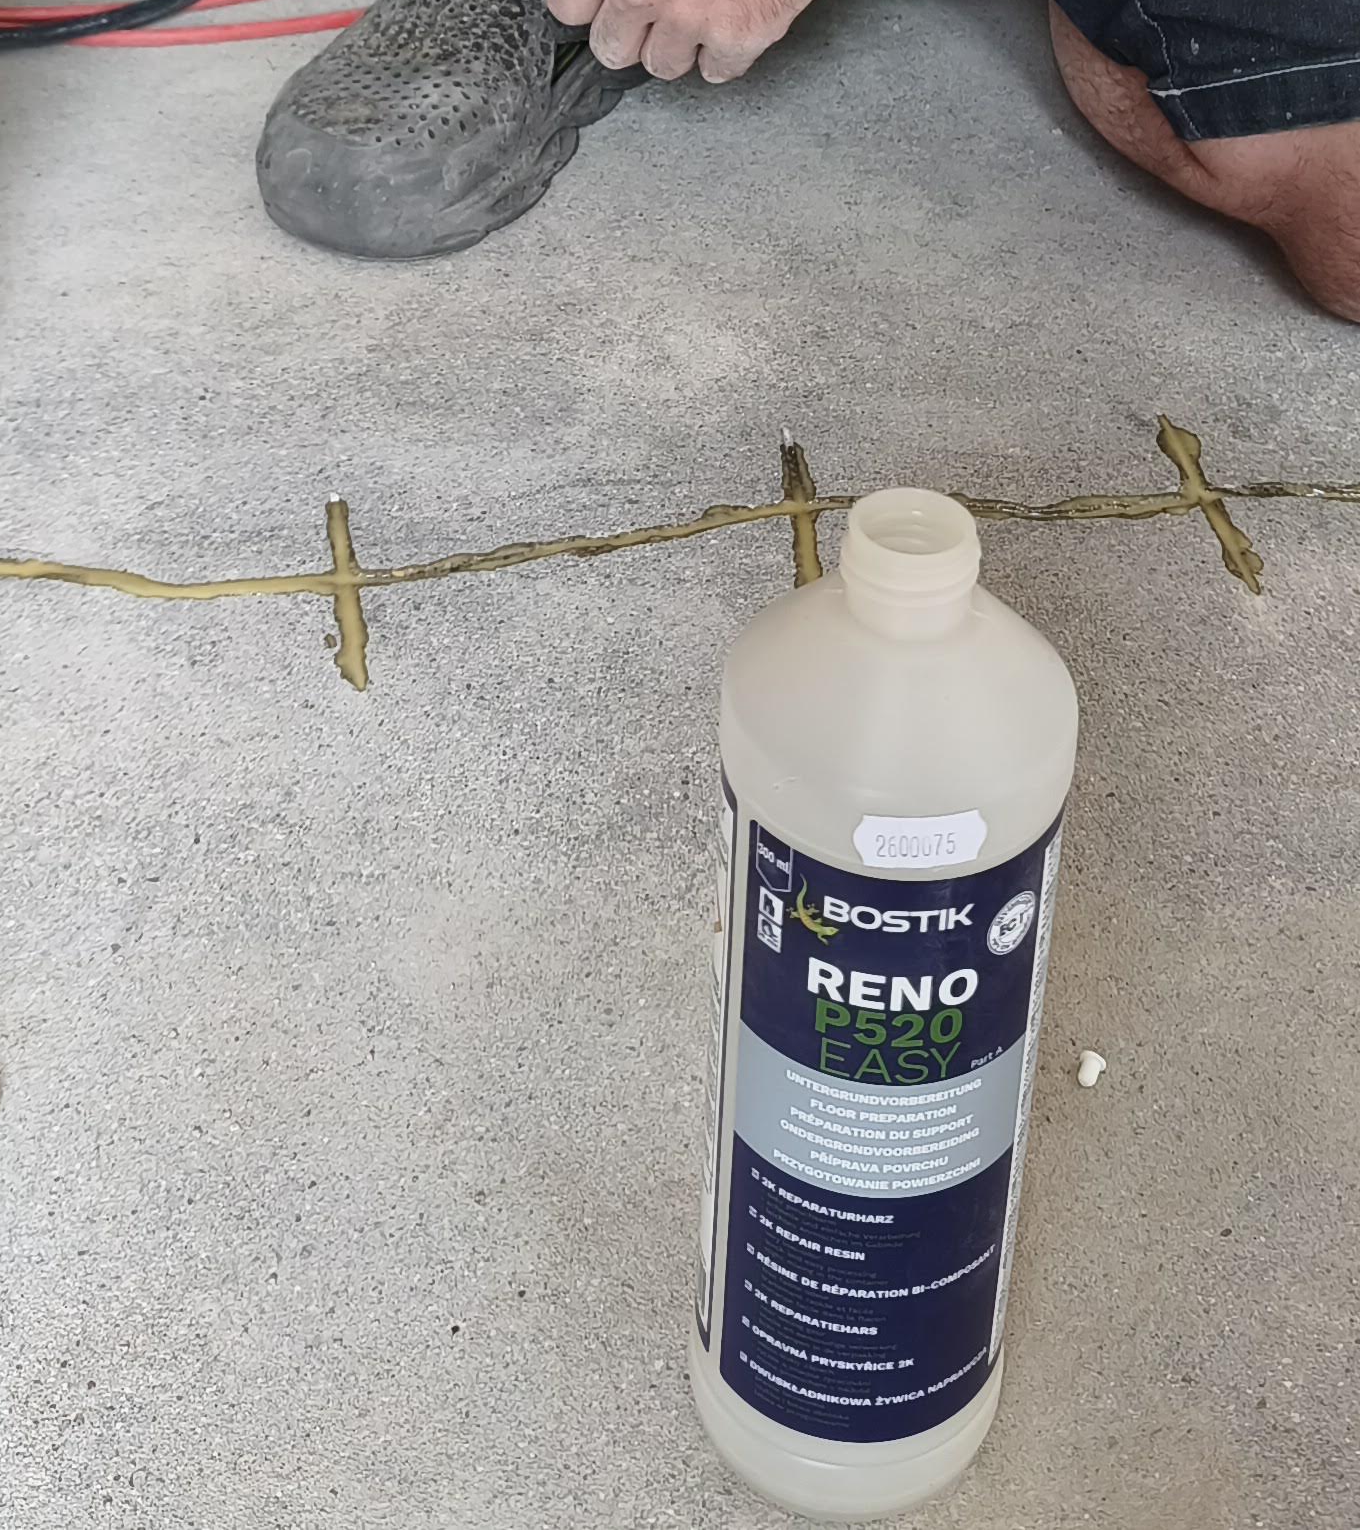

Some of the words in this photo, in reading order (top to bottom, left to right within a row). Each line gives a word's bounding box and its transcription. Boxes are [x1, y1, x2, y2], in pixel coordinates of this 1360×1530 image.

[875, 832, 957, 858] 2600075
[823, 895, 976, 933] BOSTIK
[807, 957, 979, 1012] RENO
[815, 998, 963, 1047] P520
[820, 1037, 962, 1084] EASY
[970, 1052, 994, 1069] Part
[786, 1069, 982, 1106] UNTERGRUNDVORBEREITUNG
[790, 1106, 886, 1140] PRÉPARATION
[889, 1129, 910, 1140] DU
[912, 1114, 975, 1139] SUPPORT
[810, 1098, 857, 1120] FLOOR
[859, 1105, 957, 1124] PREPARATION
[780, 1119, 980, 1157] ONDERGRONDVOORBEREIDING
[773, 1149, 889, 1190] PRZYGOTOWANIE
[892, 1157, 981, 1190] POWIERZCHNI
[810, 1150, 880, 1174] PŘÍPRAVA
[882, 1156, 949, 1174] POVRCHU
[761, 1176, 776, 1192] 2K
[778, 1188, 895, 1224] REPARATURHARZ
[759, 1215, 774, 1230] 2K
[776, 1225, 821, 1252] REPAIR
[824, 1246, 866, 1261] RESIN
[757, 1250, 798, 1281] RÉSINE
[801, 1276, 819, 1290] DE
[821, 1283, 908, 1299] RÉPARATION
[754, 1288, 769, 1304] 2K
[771, 1299, 879, 1336] REPARATIEHARS
[752, 1325, 809, 1361] OPRAVNÁ
[811, 1354, 895, 1371] PRYSKYŘICE
[898, 1357, 915, 1369] 2K
[750, 1359, 872, 1406] DWUSKŁADNIKOWA
